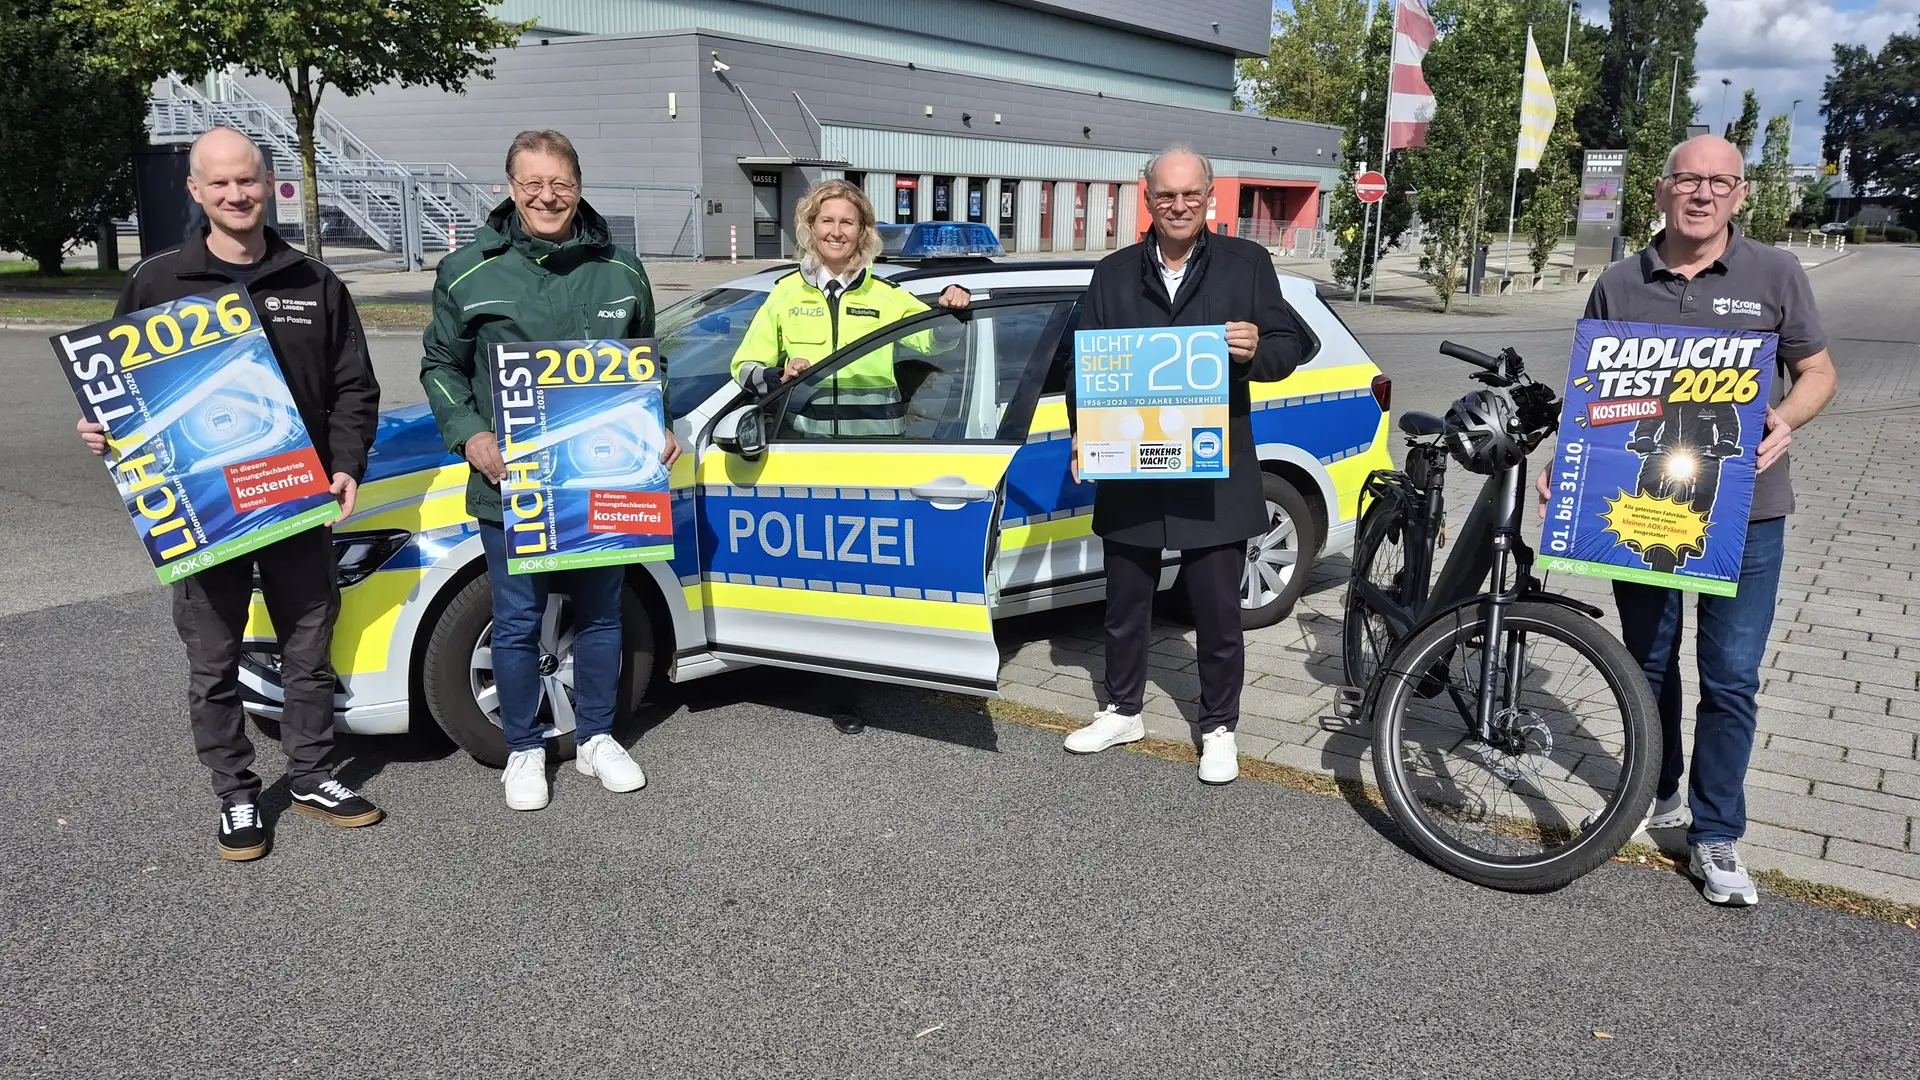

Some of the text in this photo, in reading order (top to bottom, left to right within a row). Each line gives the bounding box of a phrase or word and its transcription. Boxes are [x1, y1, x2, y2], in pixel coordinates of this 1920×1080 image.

[753, 175, 777, 184] KASSE 2
[282, 299, 318, 307] KFZ-INNUNG
[1731, 299, 1761, 310] Krone
[597, 310, 616, 319] AOK
[788, 306, 825, 318] POLIZEI
[286, 316, 312, 325] Postma
[108, 293, 251, 367] 2026
[1080, 335, 1133, 353] LICHT
[1586, 336, 1763, 371] RADLICHT
[535, 345, 655, 384] 2026
[1080, 354, 1133, 372] SICHT
[123, 372, 140, 396] 2026
[1081, 373, 1133, 393] TEST
[1598, 368, 1761, 404] TEST 2026
[536, 389, 545, 410] 2026
[1175, 397, 1222, 405] SICHERHEIT
[1592, 401, 1658, 420] KOSTENLOS
[158, 449, 171, 464] bis
[1140, 447, 1182, 456] VERKEHRS
[229, 459, 267, 474] In diesem
[1140, 457, 1168, 465] WACHT
[232, 459, 304, 485] Innungsfachbetrieb
[235, 468, 313, 500] kostenfrei
[1551, 437, 1584, 551] 01. bis 31.10.
[170, 474, 209, 546] Aktionszeitraum
[239, 496, 266, 509] testen!
[594, 501, 657, 509] Innungsfachbetrieb
[547, 485, 558, 550] Aktionszeitraum
[593, 510, 661, 523] kostenfrei
[1631, 512, 1650, 520] werden
[1634, 505, 1662, 515] getesteten
[1662, 510, 1687, 519] Fahrräder
[1622, 518, 1687, 534] kleinen AOK-Präsent
[728, 509, 914, 566] POLIZEI
[170, 557, 199, 577] AOK
[517, 560, 545, 571] AOK
[1547, 560, 1574, 571] AOK
